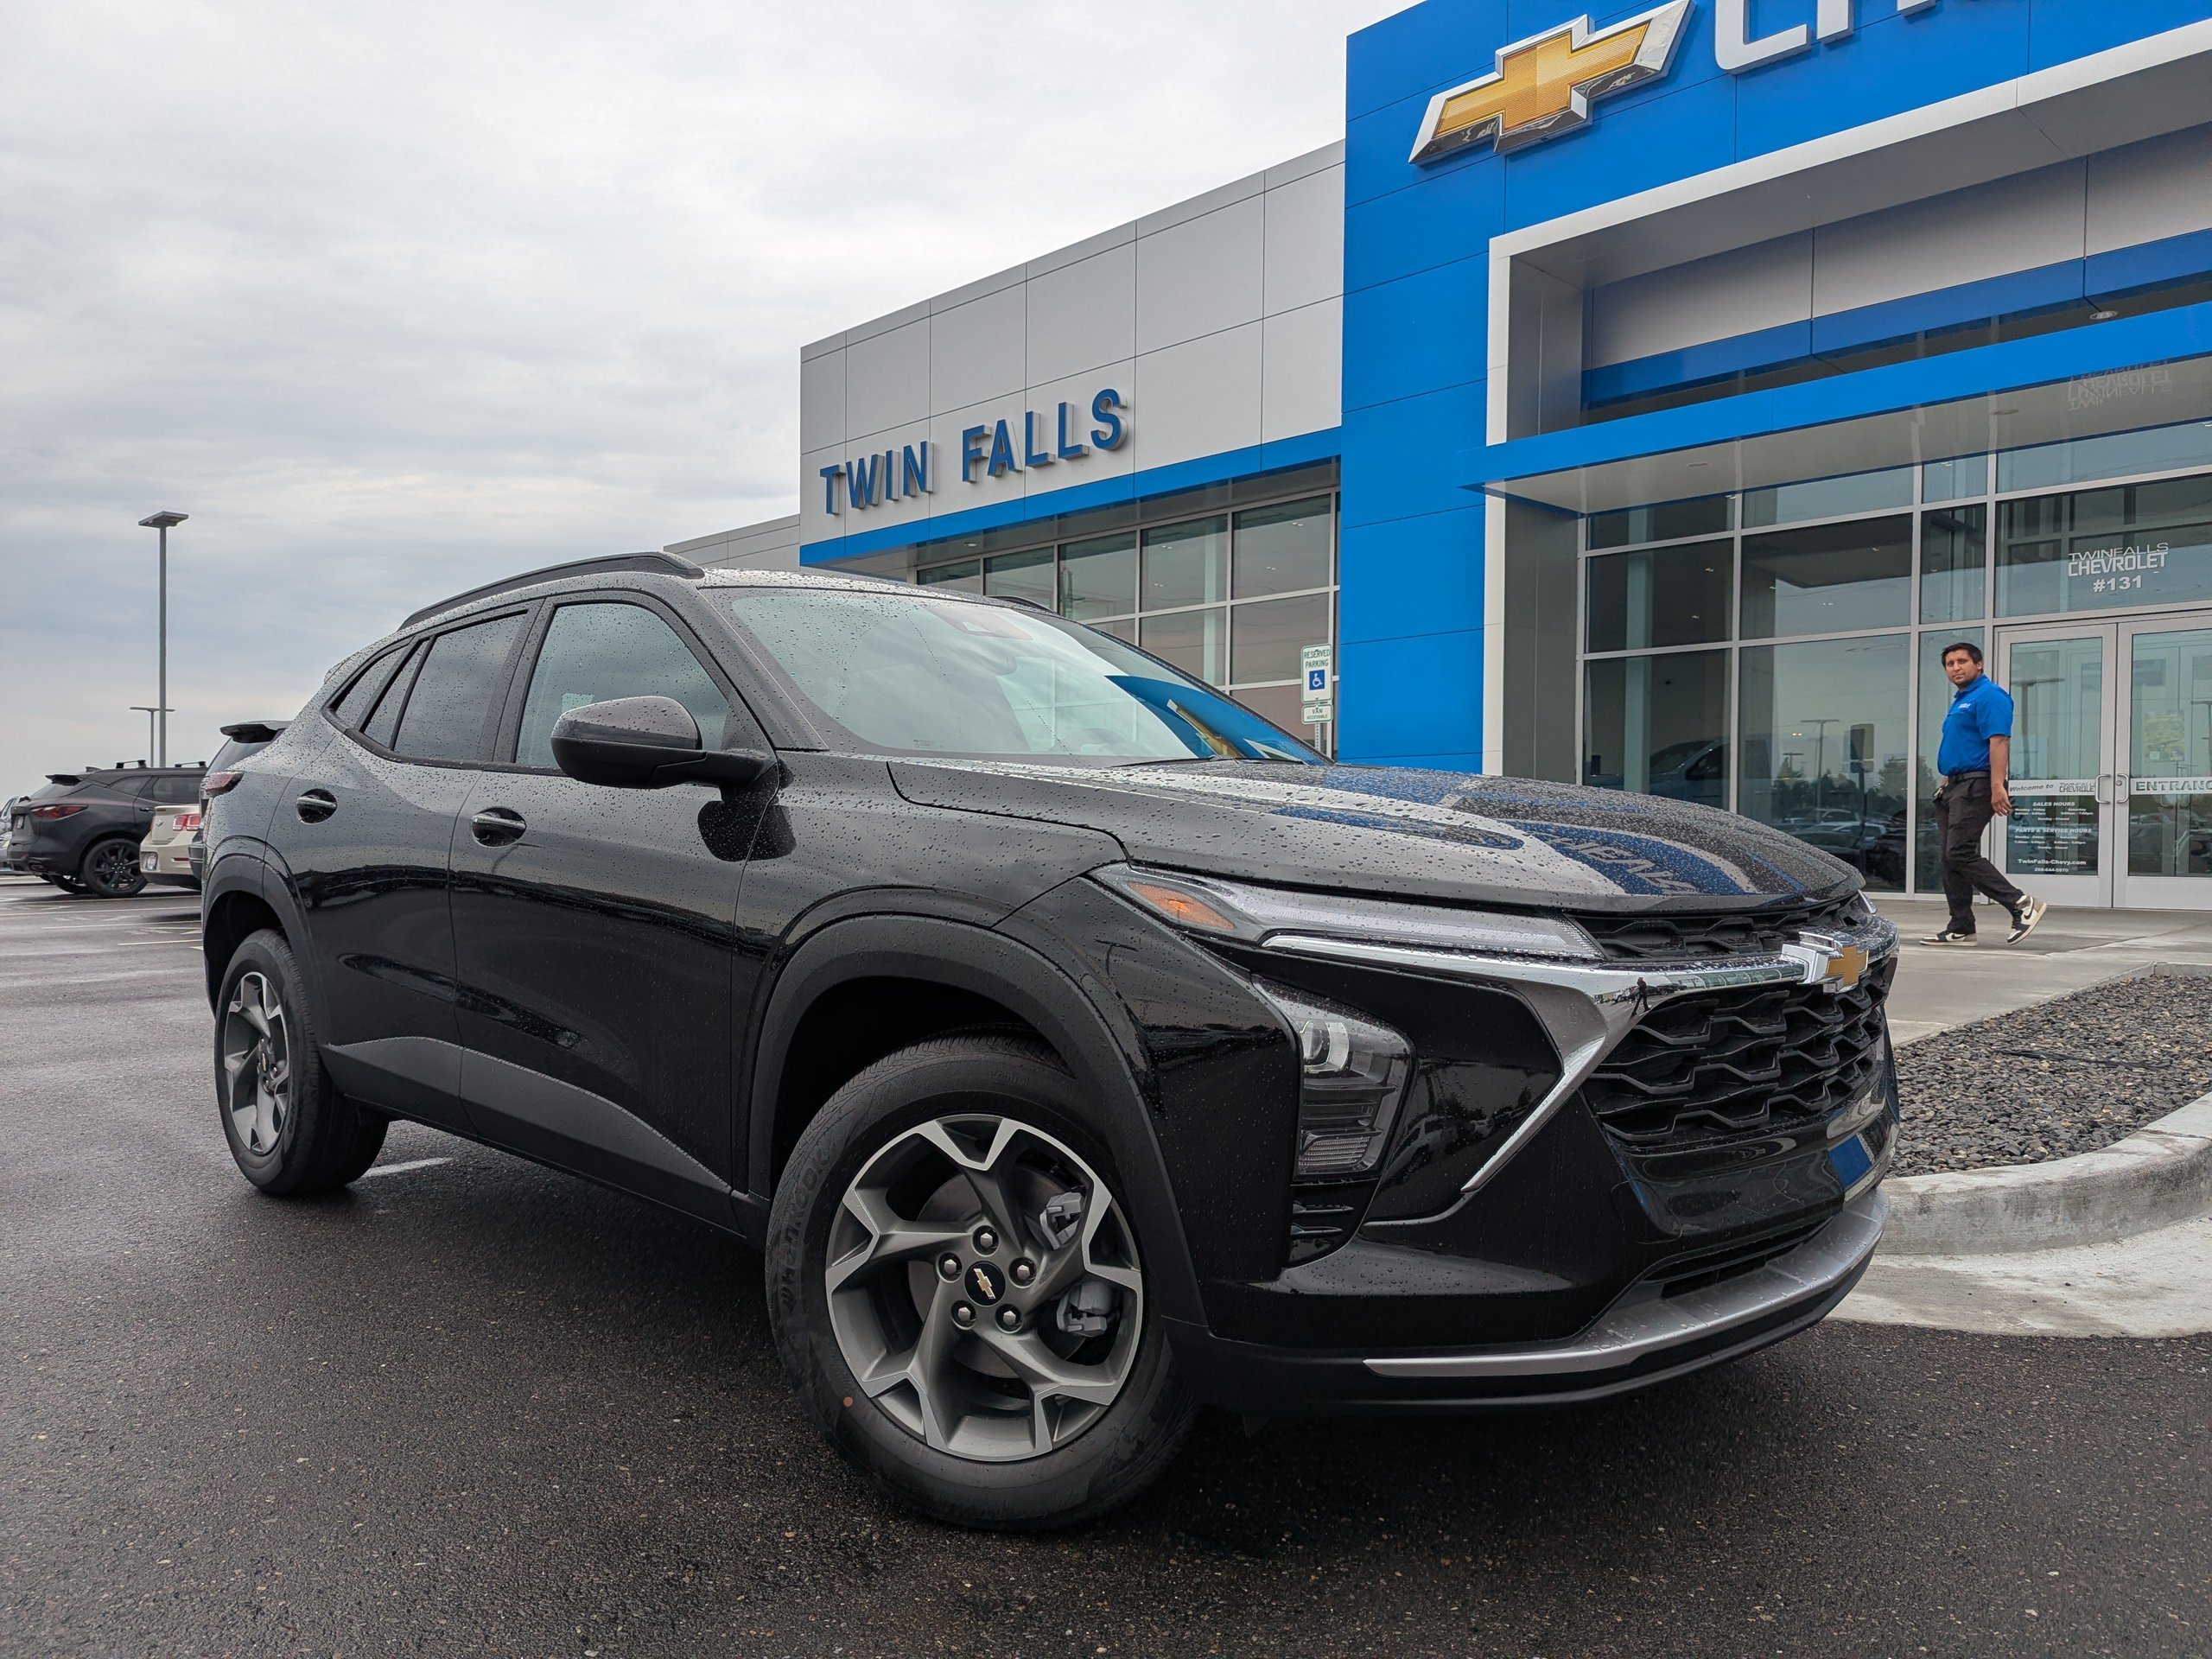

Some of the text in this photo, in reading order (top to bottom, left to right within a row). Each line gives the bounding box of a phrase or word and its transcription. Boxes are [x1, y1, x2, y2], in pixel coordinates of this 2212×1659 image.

[820, 388, 1128, 515] TWIN FALLS
[2068, 542, 2169, 562] TWINFALLS
[2068, 551, 2169, 576] CHEVROLET
[2093, 575, 2142, 593] #131
[1303, 649, 1331, 659] RESERVED
[1305, 659, 1329, 669] PARKING
